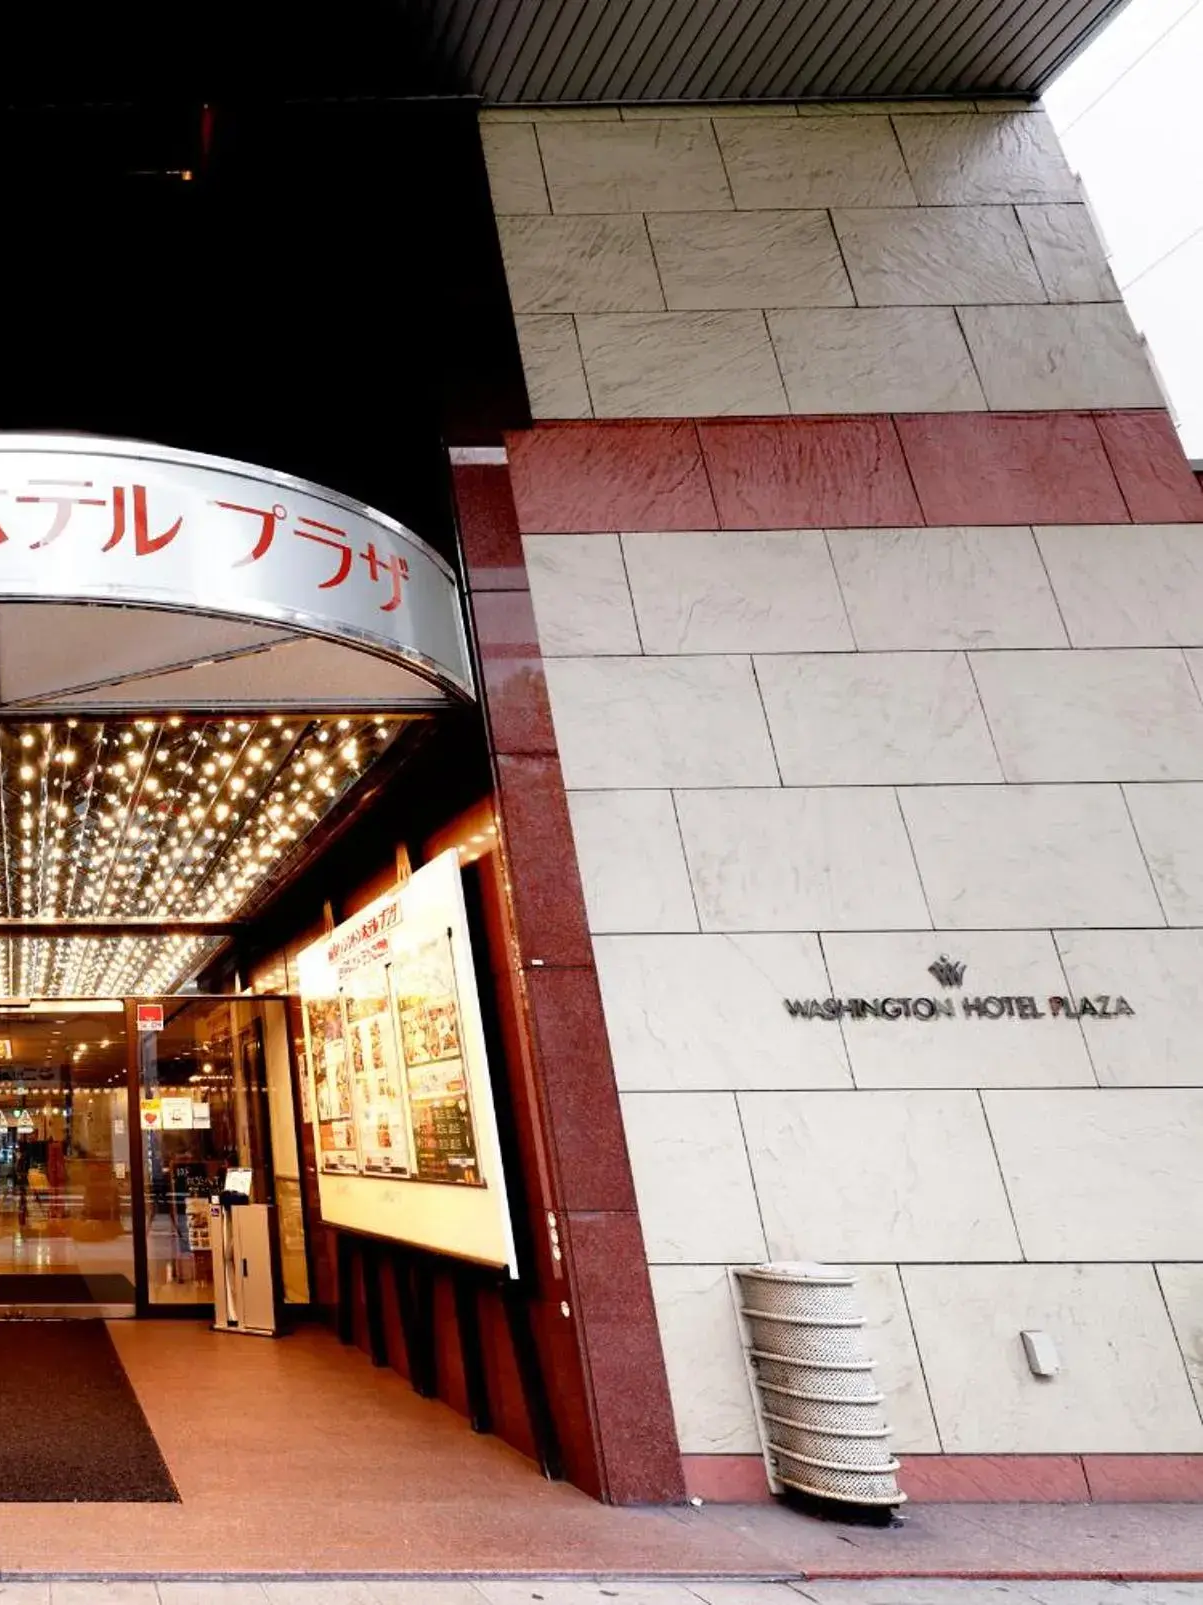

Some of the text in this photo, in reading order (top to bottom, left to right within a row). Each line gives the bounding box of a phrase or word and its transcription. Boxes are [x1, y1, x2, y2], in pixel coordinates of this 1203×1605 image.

[207, 502, 410, 612] プラザ
[784, 995, 1136, 1021] WASHINGTON HOTEL PLAZA
